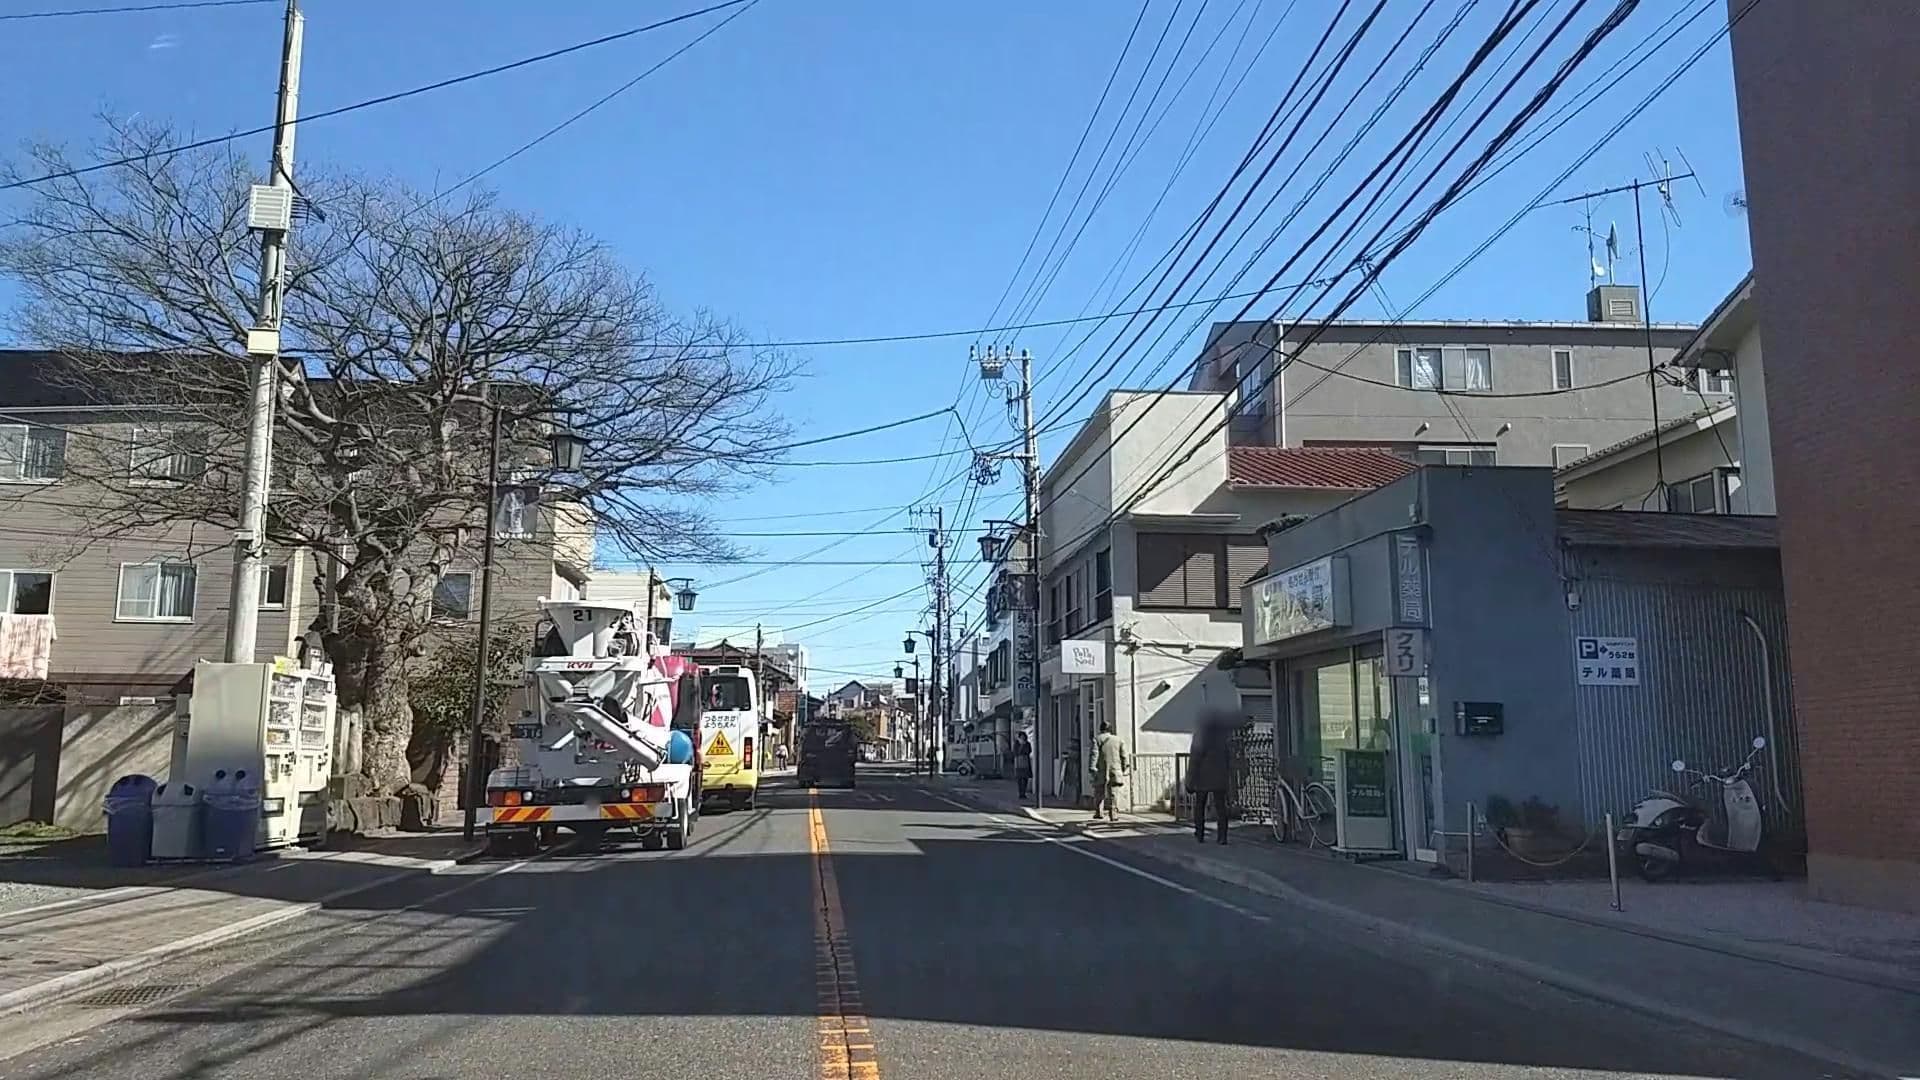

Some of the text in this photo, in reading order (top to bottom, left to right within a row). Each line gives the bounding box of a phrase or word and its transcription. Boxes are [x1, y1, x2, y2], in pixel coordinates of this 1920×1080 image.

[1400, 536, 1422, 620] テル薬局
[573, 609, 593, 622] 21
[1396, 631, 1414, 672] クスリ
[1581, 640, 1597, 658] P
[1582, 667, 1636, 679] テル薬局
